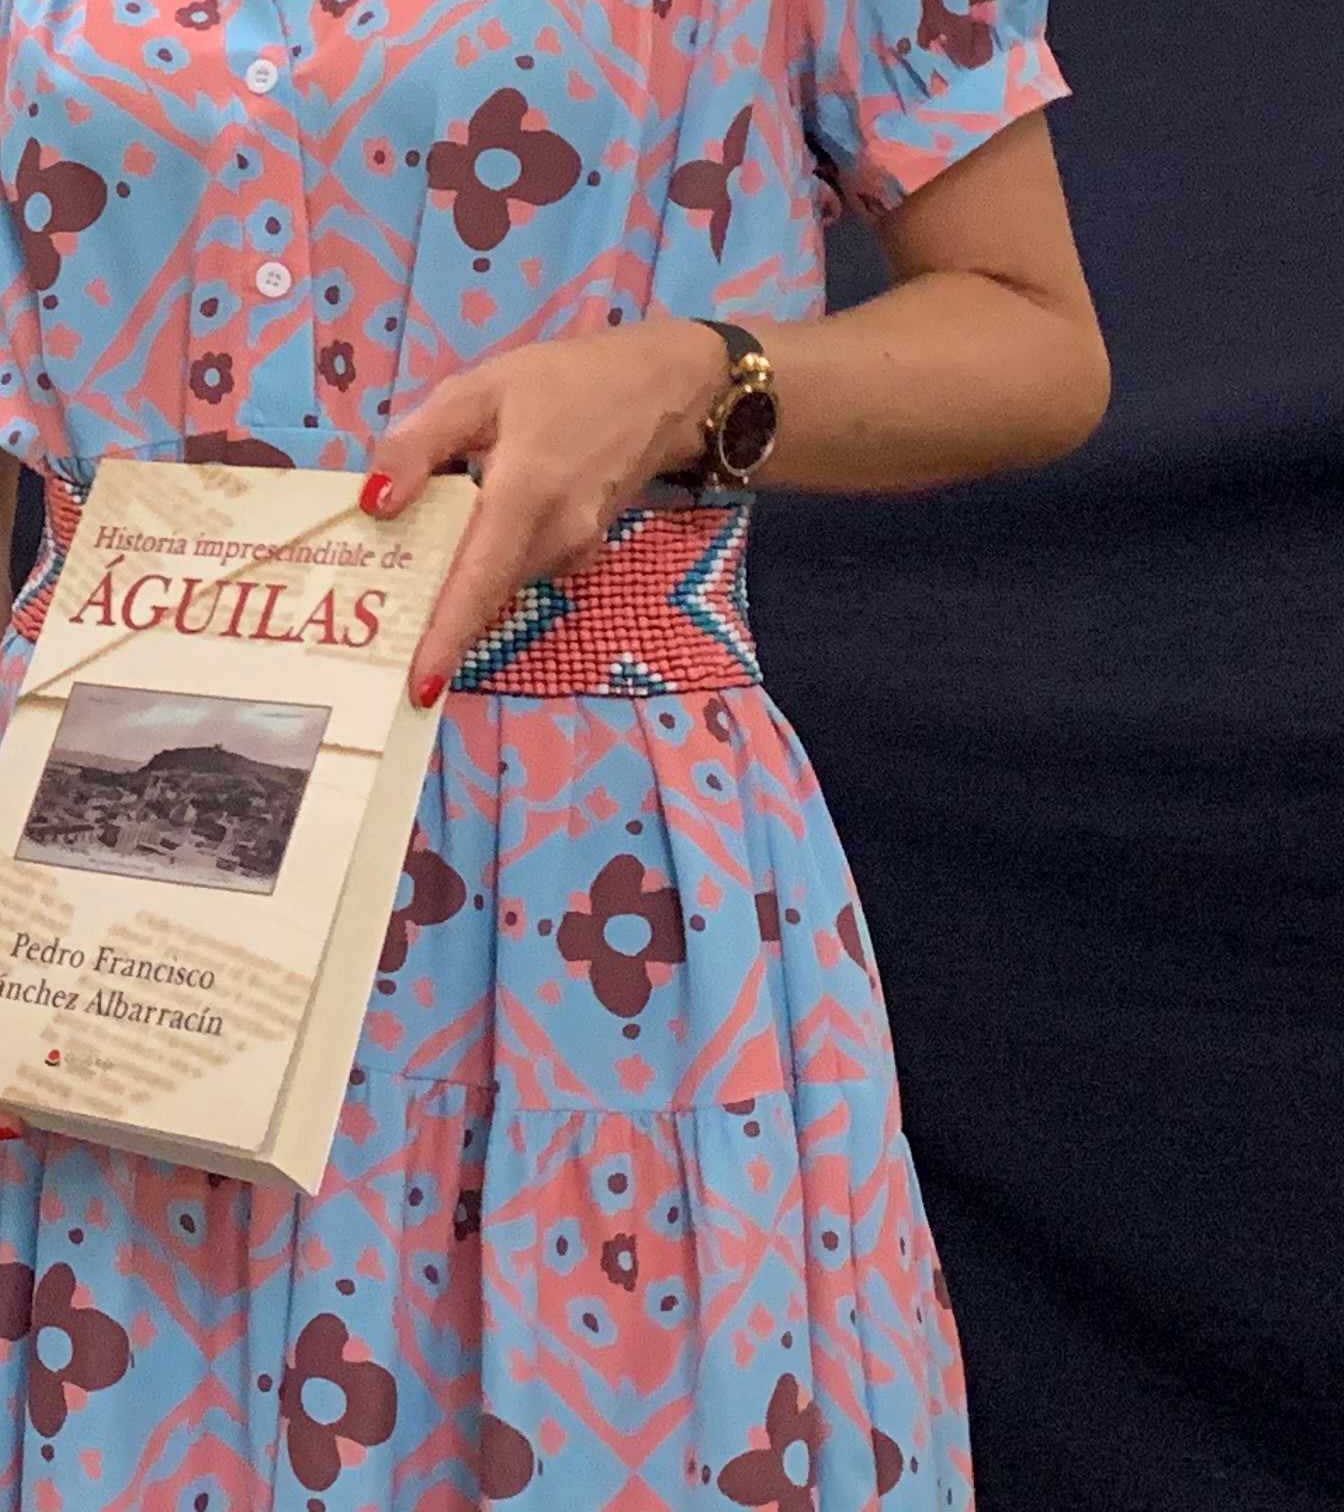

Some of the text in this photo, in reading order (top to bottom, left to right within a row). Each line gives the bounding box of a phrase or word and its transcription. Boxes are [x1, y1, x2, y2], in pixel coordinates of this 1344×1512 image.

[94, 526, 414, 569] Historia imprescindible de
[69, 554, 388, 648] ÁGUILAS
[10, 932, 216, 990] Pedro Francisco
[85, 988, 224, 1037] Albarracín
